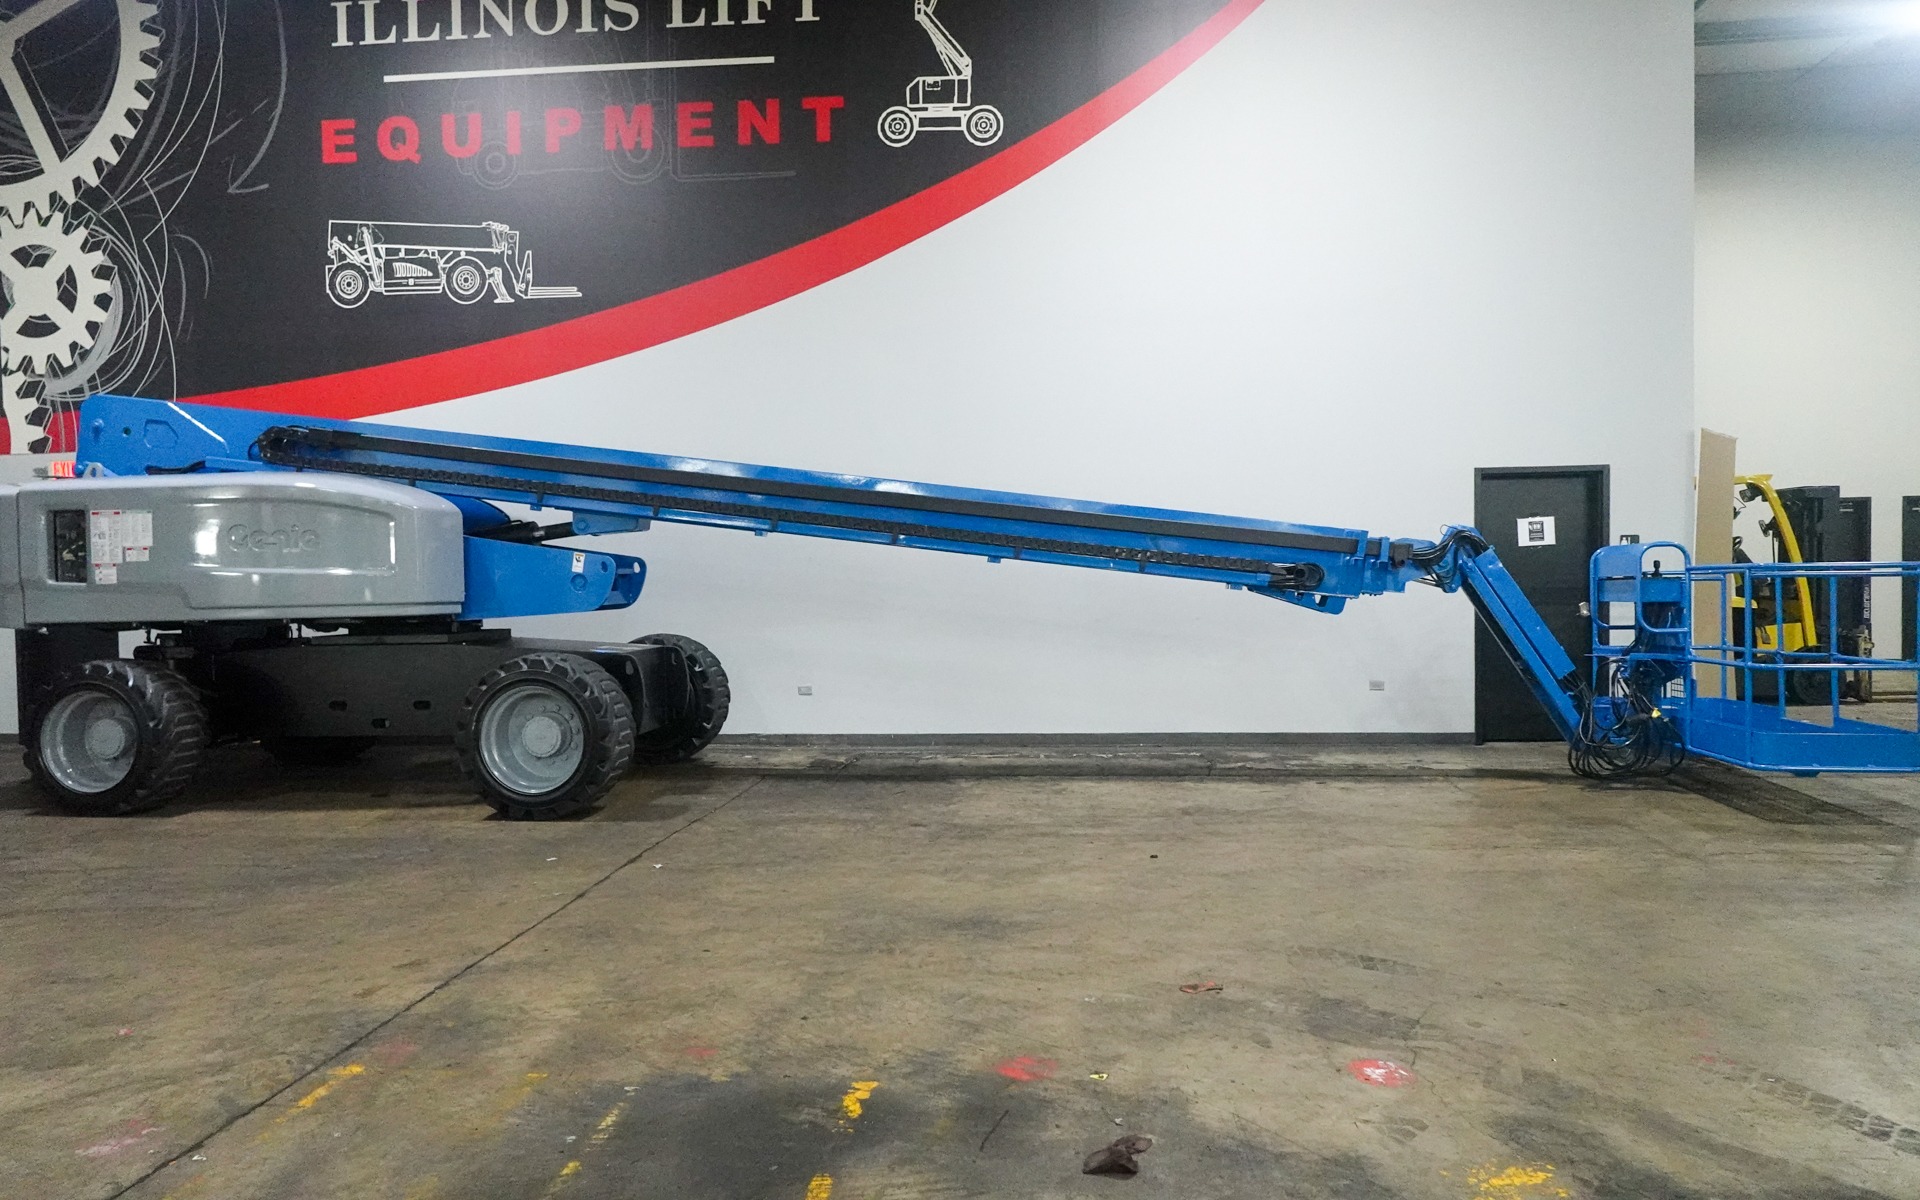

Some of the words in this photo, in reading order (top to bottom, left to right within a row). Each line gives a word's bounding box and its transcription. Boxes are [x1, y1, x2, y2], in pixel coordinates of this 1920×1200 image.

[330, 0, 640, 47] ILLINOIS
[320, 95, 845, 165] EQUIPMENT
[227, 523, 320, 553] Genie
